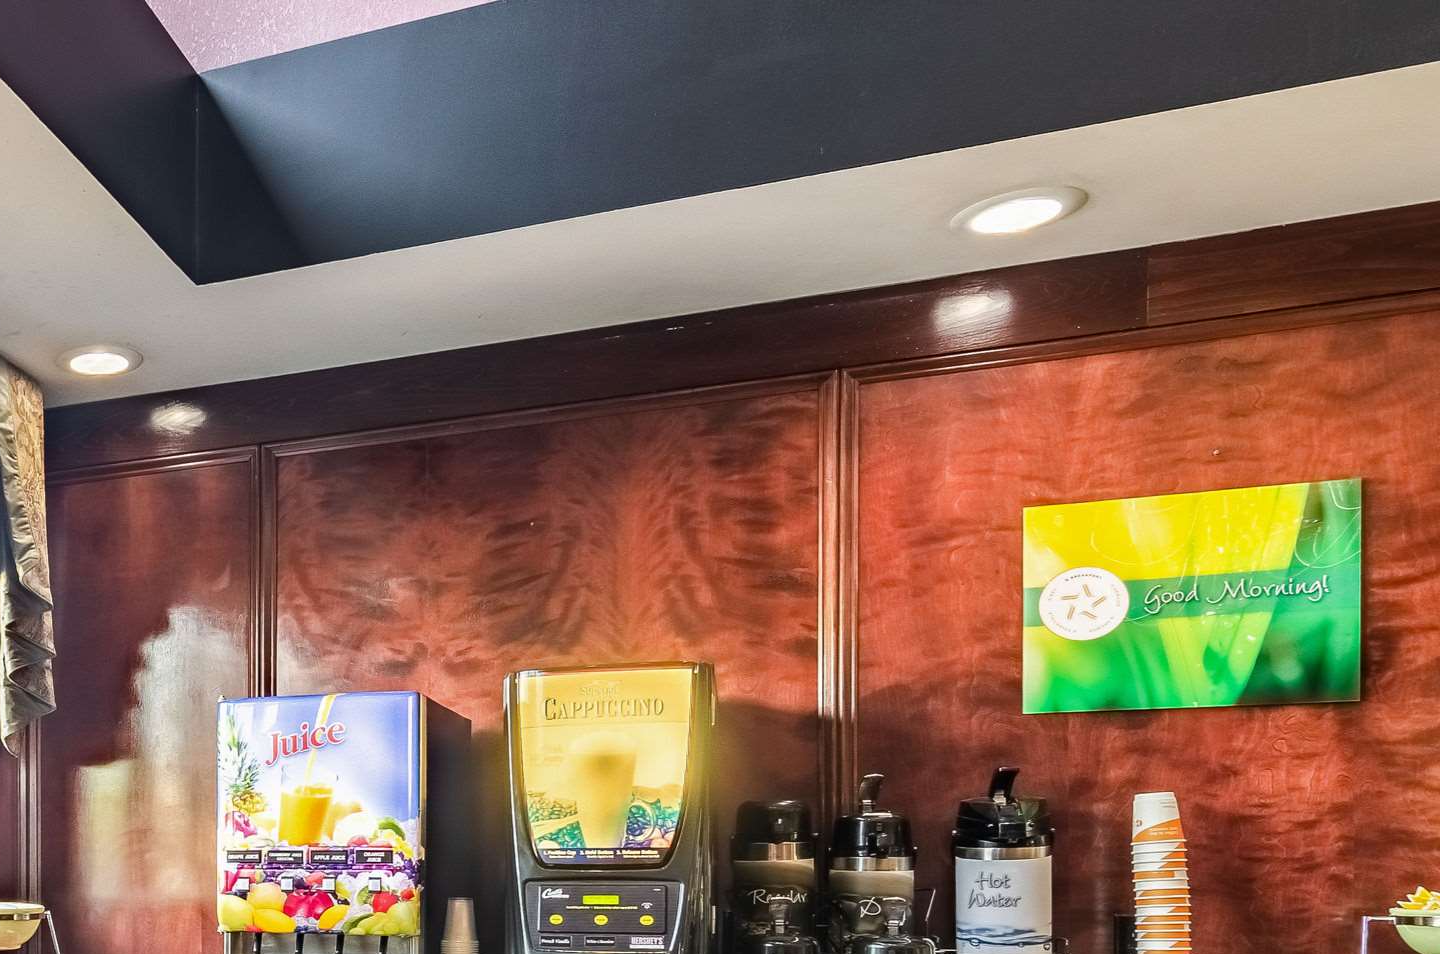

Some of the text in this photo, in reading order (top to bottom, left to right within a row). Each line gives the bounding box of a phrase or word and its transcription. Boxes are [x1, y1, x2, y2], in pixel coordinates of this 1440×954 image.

[1144, 583, 1200, 614] Good
[1206, 574, 1330, 604] Morning!
[544, 697, 665, 721] CAPPUCCINO
[263, 721, 346, 768] Juice
[974, 871, 1012, 890] Hot
[968, 888, 1022, 909] Water
